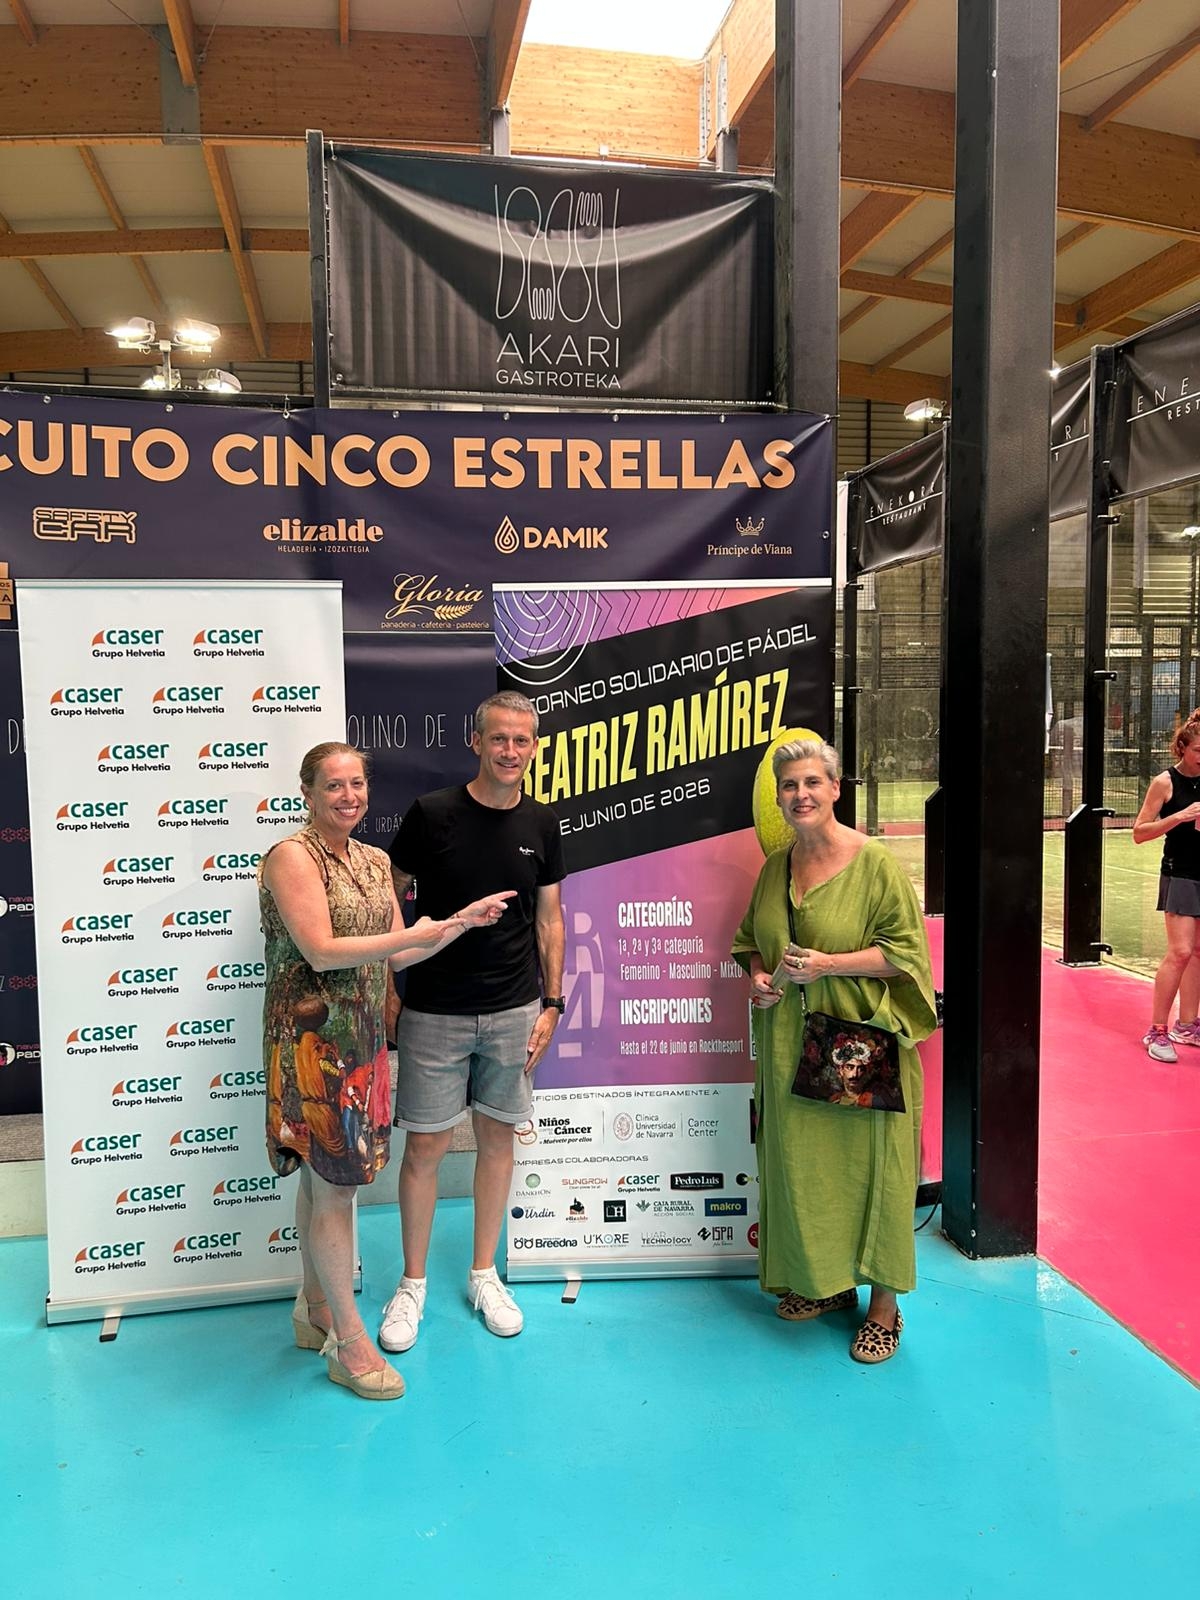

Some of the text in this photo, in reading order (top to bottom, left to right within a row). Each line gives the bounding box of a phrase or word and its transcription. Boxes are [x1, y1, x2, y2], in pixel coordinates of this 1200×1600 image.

[496, 332, 620, 369] AKARI
[496, 369, 621, 389] GASTROTEKA
[0, 419, 797, 490] UITO CINCO ESTRELLAS
[33, 507, 137, 521] SAFETY
[33, 519, 136, 543] CAR
[263, 518, 384, 542] elizalde
[523, 526, 609, 549] DAMIK
[324, 545, 370, 553] IZOZKITEGIA
[707, 543, 793, 558] Príncipe de Viana
[386, 573, 484, 614] Gloria
[106, 629, 164, 645] caser
[207, 629, 264, 644] caser
[91, 648, 166, 660] Grupo Helvetia
[193, 648, 265, 659] Grupo Helvetia
[609, 651, 714, 695] SOLIDARIO
[716, 641, 745, 666] DE
[748, 623, 817, 661] PÁDEL
[64, 687, 123, 703] caser
[166, 686, 223, 702] caser
[265, 685, 320, 701] caser
[50, 706, 125, 718] Grupo Helvetia
[152, 705, 225, 717] Grupo Helvetia
[251, 704, 322, 715] Grupo Helvetia
[646, 667, 789, 776] RAMÍREZ
[347, 714, 407, 749] OLINO
[425, 713, 447, 748] DE
[111, 743, 169, 760] caser
[211, 742, 268, 758] caser
[97, 762, 171, 774] Grupo Helvetia
[198, 760, 270, 772] Grupo Helvetia
[70, 801, 128, 818] caser
[171, 799, 228, 815] caser
[572, 778, 711, 833] JUNIO DE 2026
[56, 820, 130, 833] Grupo Helvetia
[157, 817, 229, 829] Grupo Helvetia
[116, 856, 174, 873] caser
[103, 875, 176, 887] Grupo Helvetia
[175, 909, 232, 925] caser
[618, 896, 693, 928] CATEGORÍAS
[75, 914, 133, 931] caser
[61, 932, 135, 945] Grupo Helvetia
[162, 927, 233, 940] Grupo Helvetia
[644, 939, 650, 956] y
[664, 936, 704, 955] categoría
[121, 967, 178, 984] caser
[620, 960, 743, 980] Femenino Masculino Mixto
[107, 985, 180, 998] Grupo Helvetia
[620, 997, 713, 1025] INSCRIPCIONES
[620, 1040, 640, 1055] Hasta
[641, 1040, 648, 1055] el
[649, 1040, 658, 1054] 22
[659, 1039, 668, 1054] de
[669, 1039, 688, 1055] junio
[689, 1041, 698, 1053] en
[125, 1076, 182, 1094] caser
[112, 1094, 183, 1108] Grupo Helvetia
[569, 1091, 632, 1100] DESTINADOS
[538, 1117, 571, 1127] Niños
[635, 1122, 676, 1130] Universidad
[688, 1118, 719, 1128] Cancer
[183, 1125, 239, 1143] caser
[554, 1125, 592, 1135] Cáncer
[646, 1130, 674, 1138] Navarra
[688, 1128, 718, 1137] Center
[85, 1133, 142, 1152] caser
[169, 1143, 239, 1158] Grupo Helvetia
[70, 1151, 143, 1166] Grupo Helvetia
[564, 1155, 649, 1163] COLABORADORAS
[226, 1175, 280, 1193] caser
[561, 1178, 608, 1186] SUNGROW
[626, 1174, 660, 1185] caser
[674, 1176, 720, 1185] Pedro Luis
[129, 1183, 186, 1202] caser
[213, 1192, 282, 1207] Grupo Helvetia
[115, 1201, 187, 1216] Grupo Helvetia
[525, 1208, 556, 1219] Urdin
[710, 1202, 742, 1212] makro
[186, 1231, 242, 1250] caser
[535, 1238, 578, 1248] Breedna
[88, 1241, 145, 1260] caser
[173, 1249, 243, 1264] Grupo Helvetia
[74, 1259, 147, 1274] Grupo Helvetia
